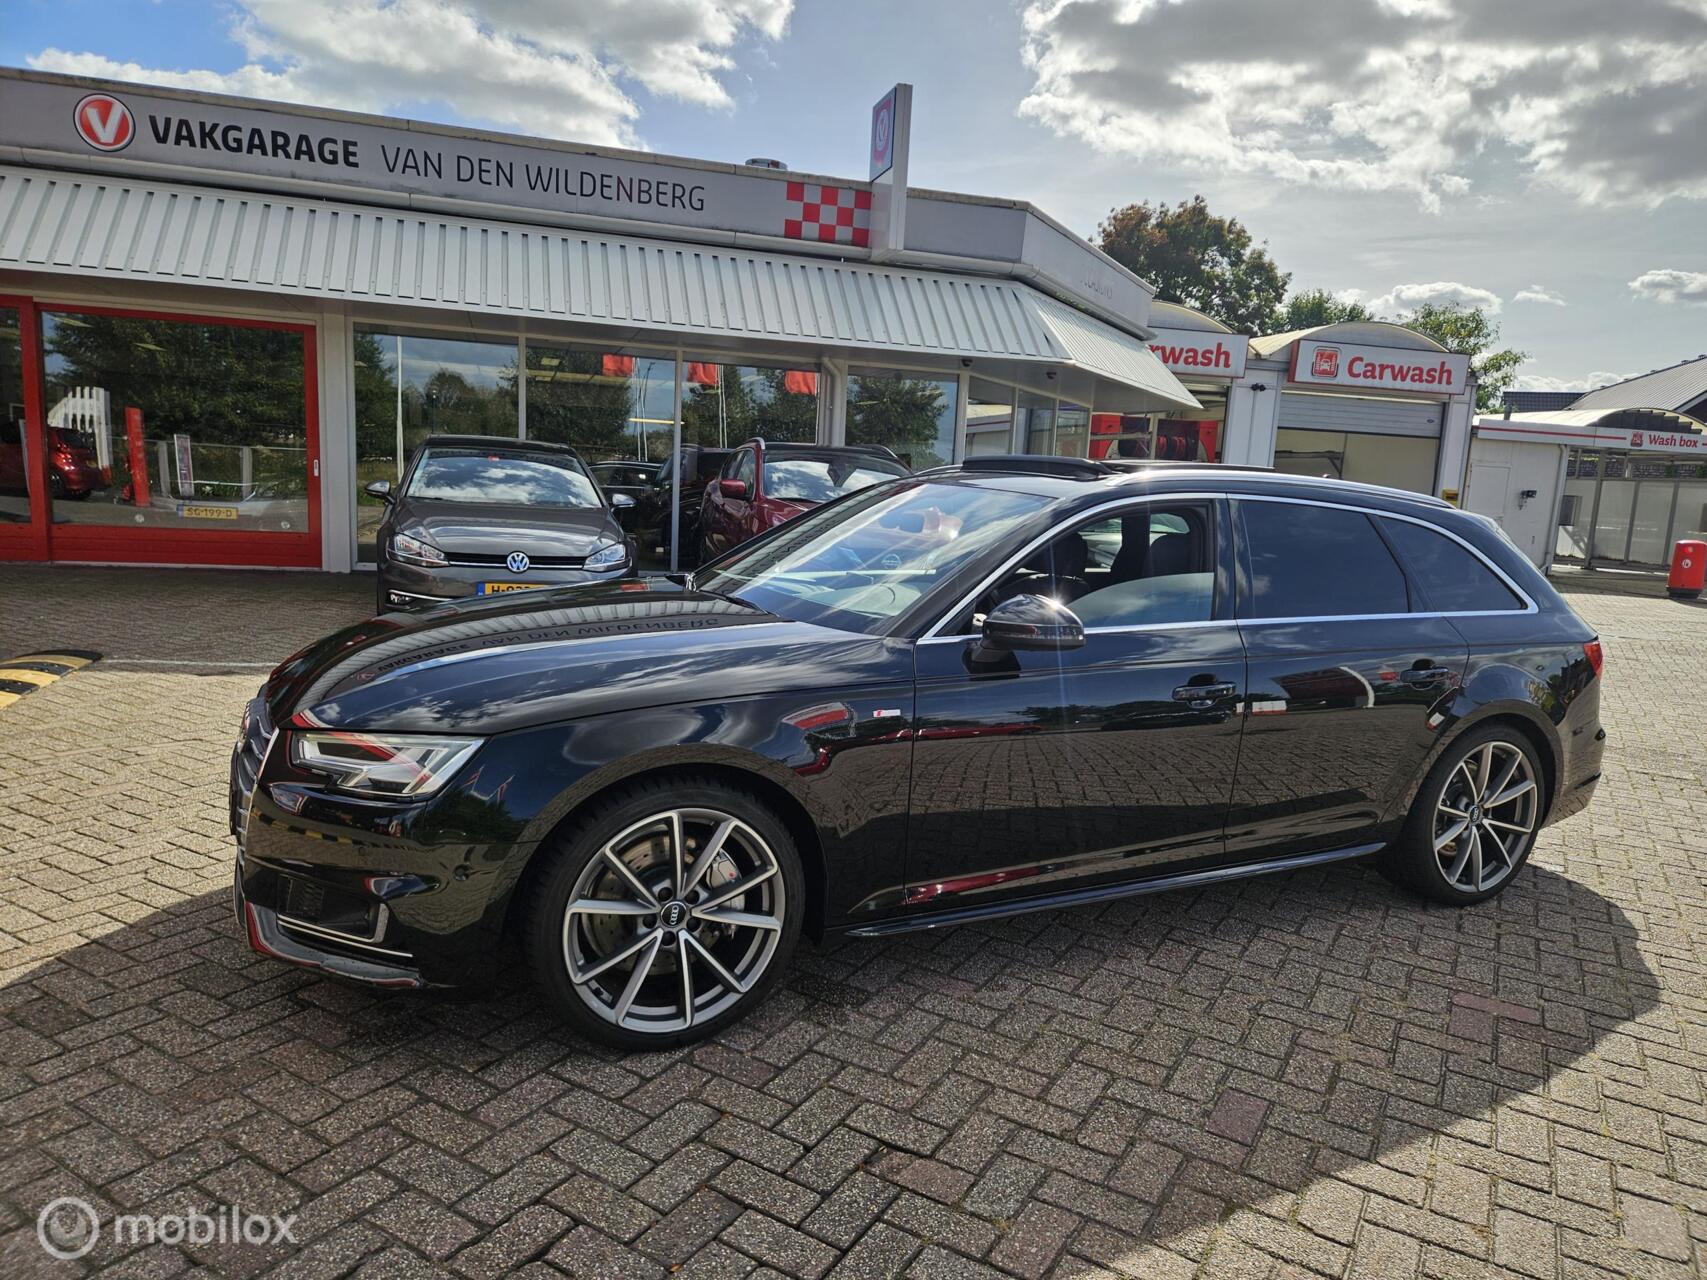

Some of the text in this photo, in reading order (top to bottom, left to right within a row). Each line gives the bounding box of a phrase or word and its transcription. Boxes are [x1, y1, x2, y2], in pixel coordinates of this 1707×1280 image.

[148, 114, 706, 212] VAKGARAGE VAN DEN WILDENBERG
[1346, 356, 1453, 386] Carwash
[1648, 433, 1698, 448] Wash box
